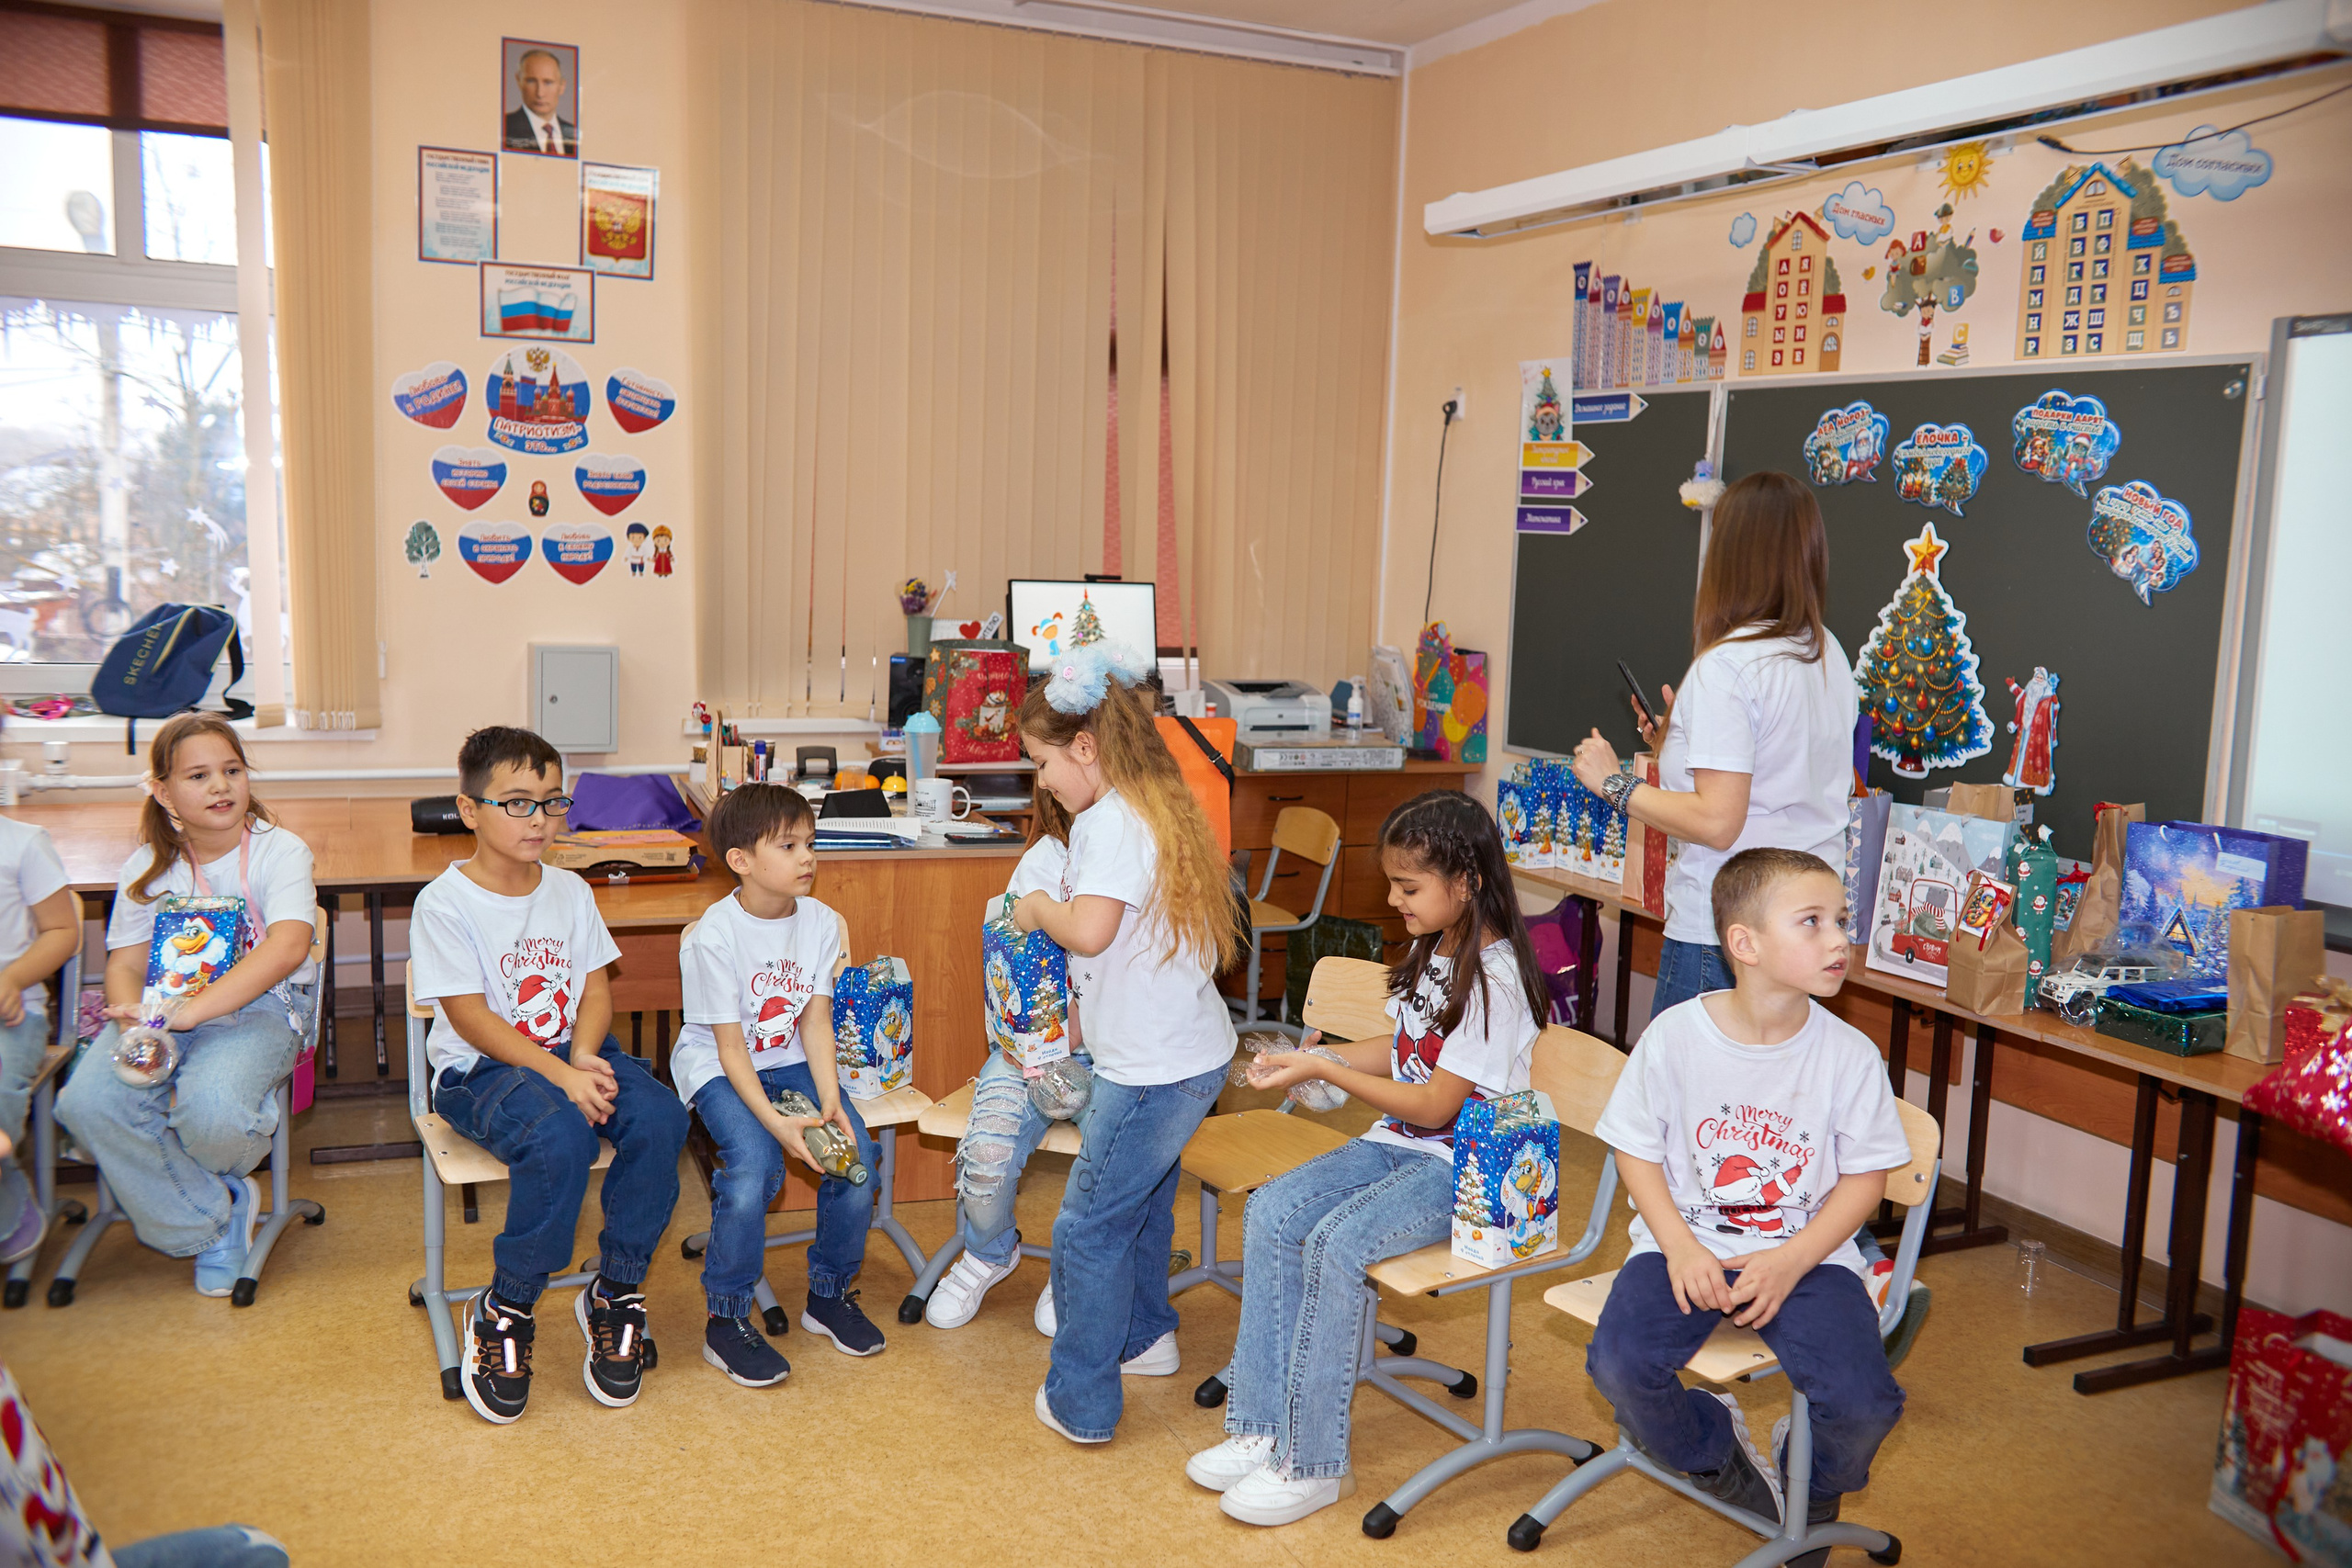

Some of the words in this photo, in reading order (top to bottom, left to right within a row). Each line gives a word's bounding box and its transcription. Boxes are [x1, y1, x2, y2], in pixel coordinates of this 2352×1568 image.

[2165, 152, 2195, 169] Дом
[2195, 158, 2265, 175] согласных
[1832, 202, 1850, 217] Дом
[1850, 209, 1886, 226] гласных
[2098, 212, 2112, 226] П
[2075, 216, 2086, 230] Б
[2033, 243, 2045, 260] Й
[2073, 241, 2084, 254] В
[2097, 237, 2109, 253] Ф
[2071, 265, 2082, 278] Г
[2095, 263, 2107, 276] К
[2136, 257, 2149, 272] Х
[2031, 267, 2043, 281] Л
[2068, 288, 2080, 302] Д
[2093, 287, 2104, 300] Т
[2133, 282, 2147, 298] Ц
[2029, 292, 2041, 306] М
[2064, 313, 2079, 327] Ж
[2089, 311, 2104, 325] Ш
[2132, 308, 2144, 322] Ч
[2166, 305, 2180, 321] Ъ
[2028, 315, 2040, 330] Н
[2064, 338, 2075, 352] З
[2091, 337, 2100, 351] С
[2128, 332, 2143, 348] Щ
[2164, 330, 2177, 345] Ь
[2027, 339, 2037, 353] Р
[2032, 409, 2074, 422] ПОДАРКИ
[2074, 413, 2105, 424] ДАРЯТ
[2024, 419, 2059, 431] радость
[1916, 430, 1960, 445] ЁЛОЧКА
[2123, 487, 2163, 517] НОВЫЙ
[2162, 509, 2184, 531] ГОД
[123, 622, 164, 686] SKECHE
[521, 937, 564, 953] Merry
[500, 947, 572, 979] Christma
[777, 959, 803, 978] Mey
[1735, 1104, 1793, 1133] Merry
[1696, 1117, 1815, 1168] Christmas
